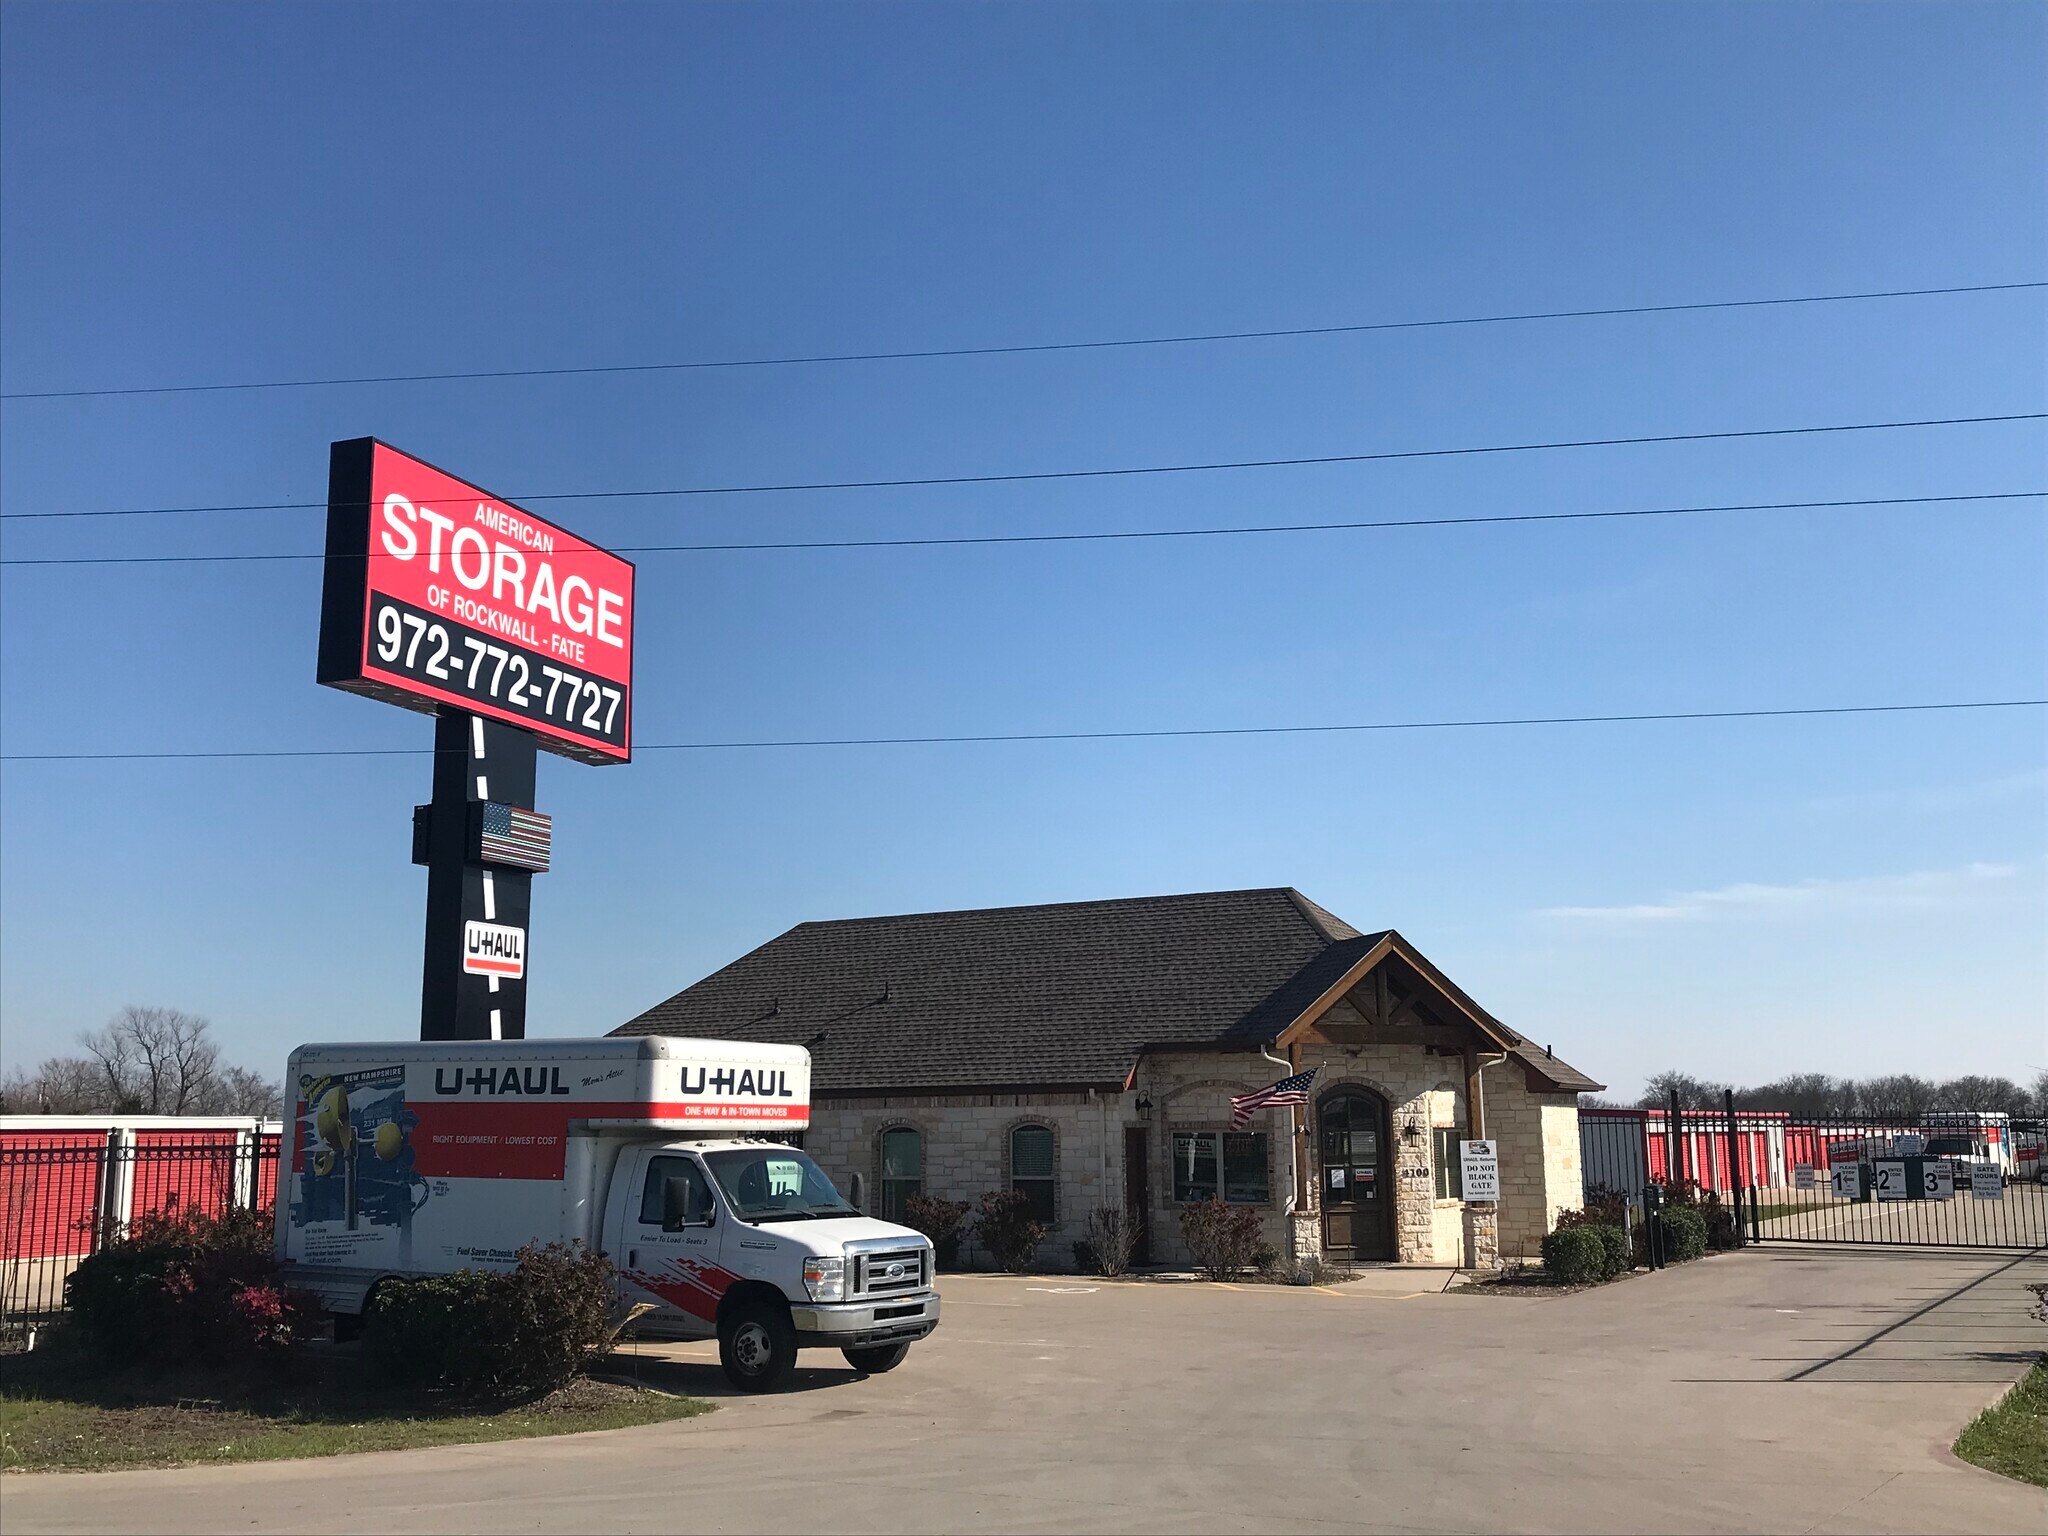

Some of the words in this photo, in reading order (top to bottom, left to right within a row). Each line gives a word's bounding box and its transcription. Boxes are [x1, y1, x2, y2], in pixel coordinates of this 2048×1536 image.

[474, 503, 553, 556] AMERICAN
[382, 493, 623, 649] STORAGE
[428, 584, 449, 609] OF
[454, 595, 539, 647] ROCKWALL
[552, 633, 585, 664] FATE
[377, 605, 621, 735] 972-772-7727
[469, 929, 520, 959] U-HAUL
[344, 1074, 360, 1083] NEW
[361, 1067, 402, 1081] HAMPSHIRE
[435, 1066, 569, 1095] U-HAUL
[581, 1075, 604, 1087] Mom's
[605, 1069, 624, 1081] Attic
[681, 1066, 792, 1097] U-HAUL
[685, 1106, 721, 1116] ONE-WAY
[721, 1107, 727, 1116] &
[728, 1107, 761, 1117] IN-TOWN
[762, 1108, 788, 1117] MOVES
[432, 1136, 453, 1144] RIGHT
[455, 1136, 498, 1145] EQUIPMENT
[505, 1136, 535, 1145] LOWEST
[537, 1136, 558, 1145] COST
[1468, 1173, 1495, 1181] BLOCK
[1833, 1172, 1842, 1191] 1
[1879, 1169, 1890, 1190] 2
[1925, 1172, 1939, 1192] 3
[640, 1234, 658, 1242] Easier
[658, 1235, 666, 1243] To
[666, 1236, 682, 1244] Load
[456, 1246, 470, 1256] Fuel
[470, 1247, 488, 1257] Saver
[488, 1248, 513, 1258] Chassis
